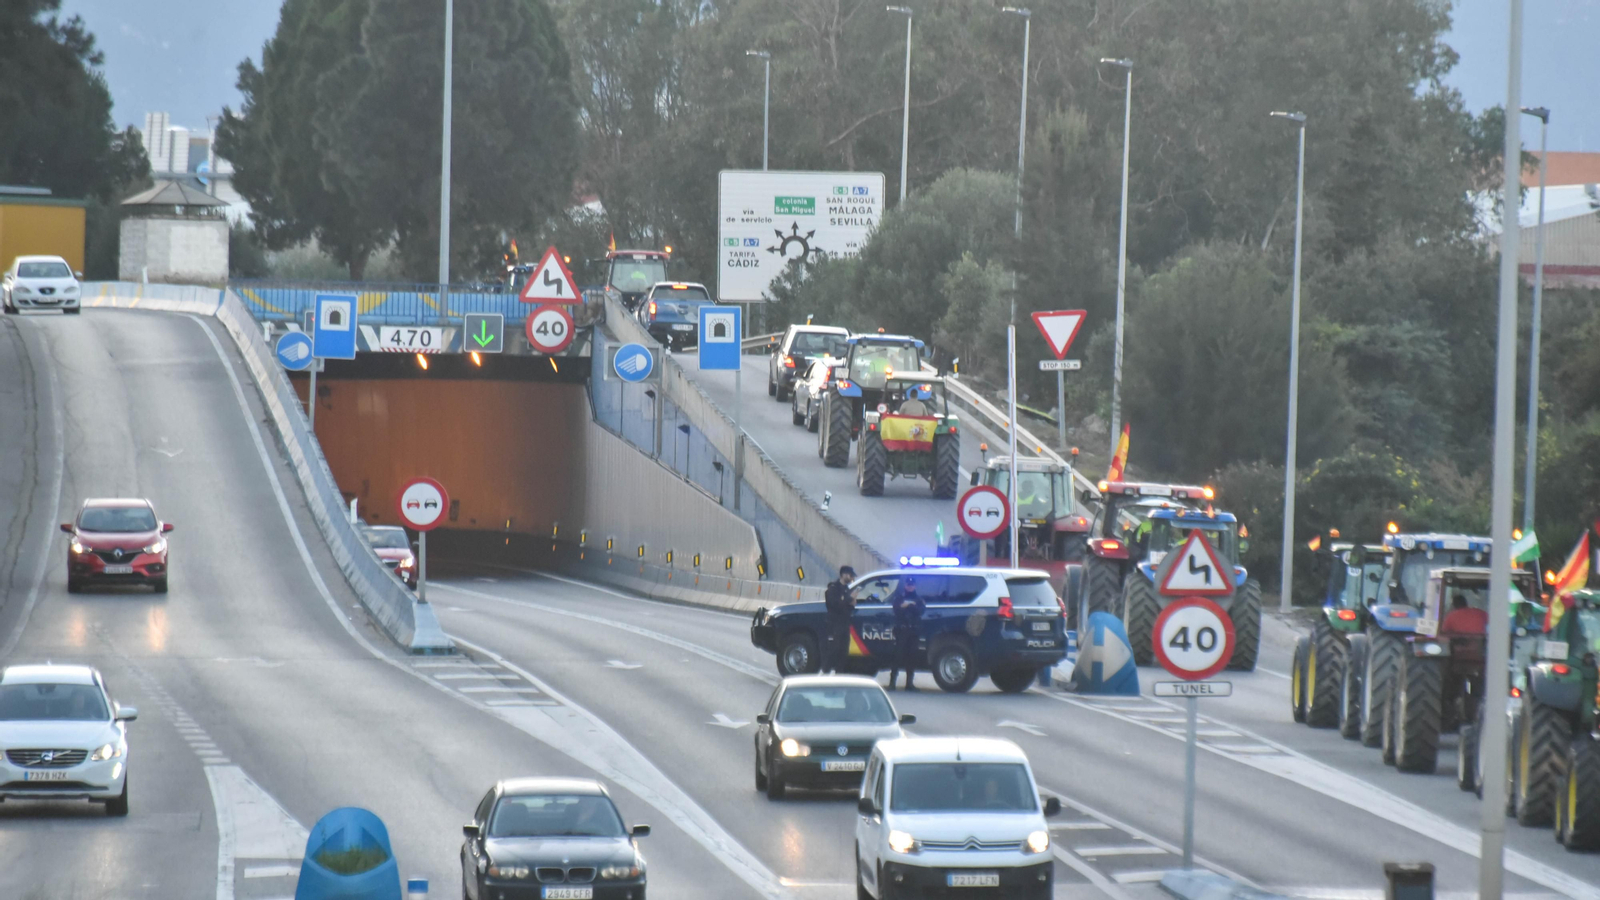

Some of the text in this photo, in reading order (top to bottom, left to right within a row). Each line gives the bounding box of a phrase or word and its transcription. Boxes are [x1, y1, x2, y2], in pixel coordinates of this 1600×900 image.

[853, 187, 868, 195] A-7
[782, 197, 808, 205] colonia
[791, 206, 815, 214] Miguel
[829, 205, 873, 215] MÁLAGA
[830, 217, 873, 226] SEVILLA
[744, 238, 759, 246] A-7
[727, 258, 760, 268] CÁDIZ
[535, 320, 565, 337] 40
[390, 329, 432, 347] 4,70
[1169, 626, 1218, 653] 40
[1173, 684, 1214, 694] TUNEL
[51, 771, 68, 780] HZK
[954, 876, 998, 886] 7217 LFN
[547, 889, 592, 899] 2949 CFR
